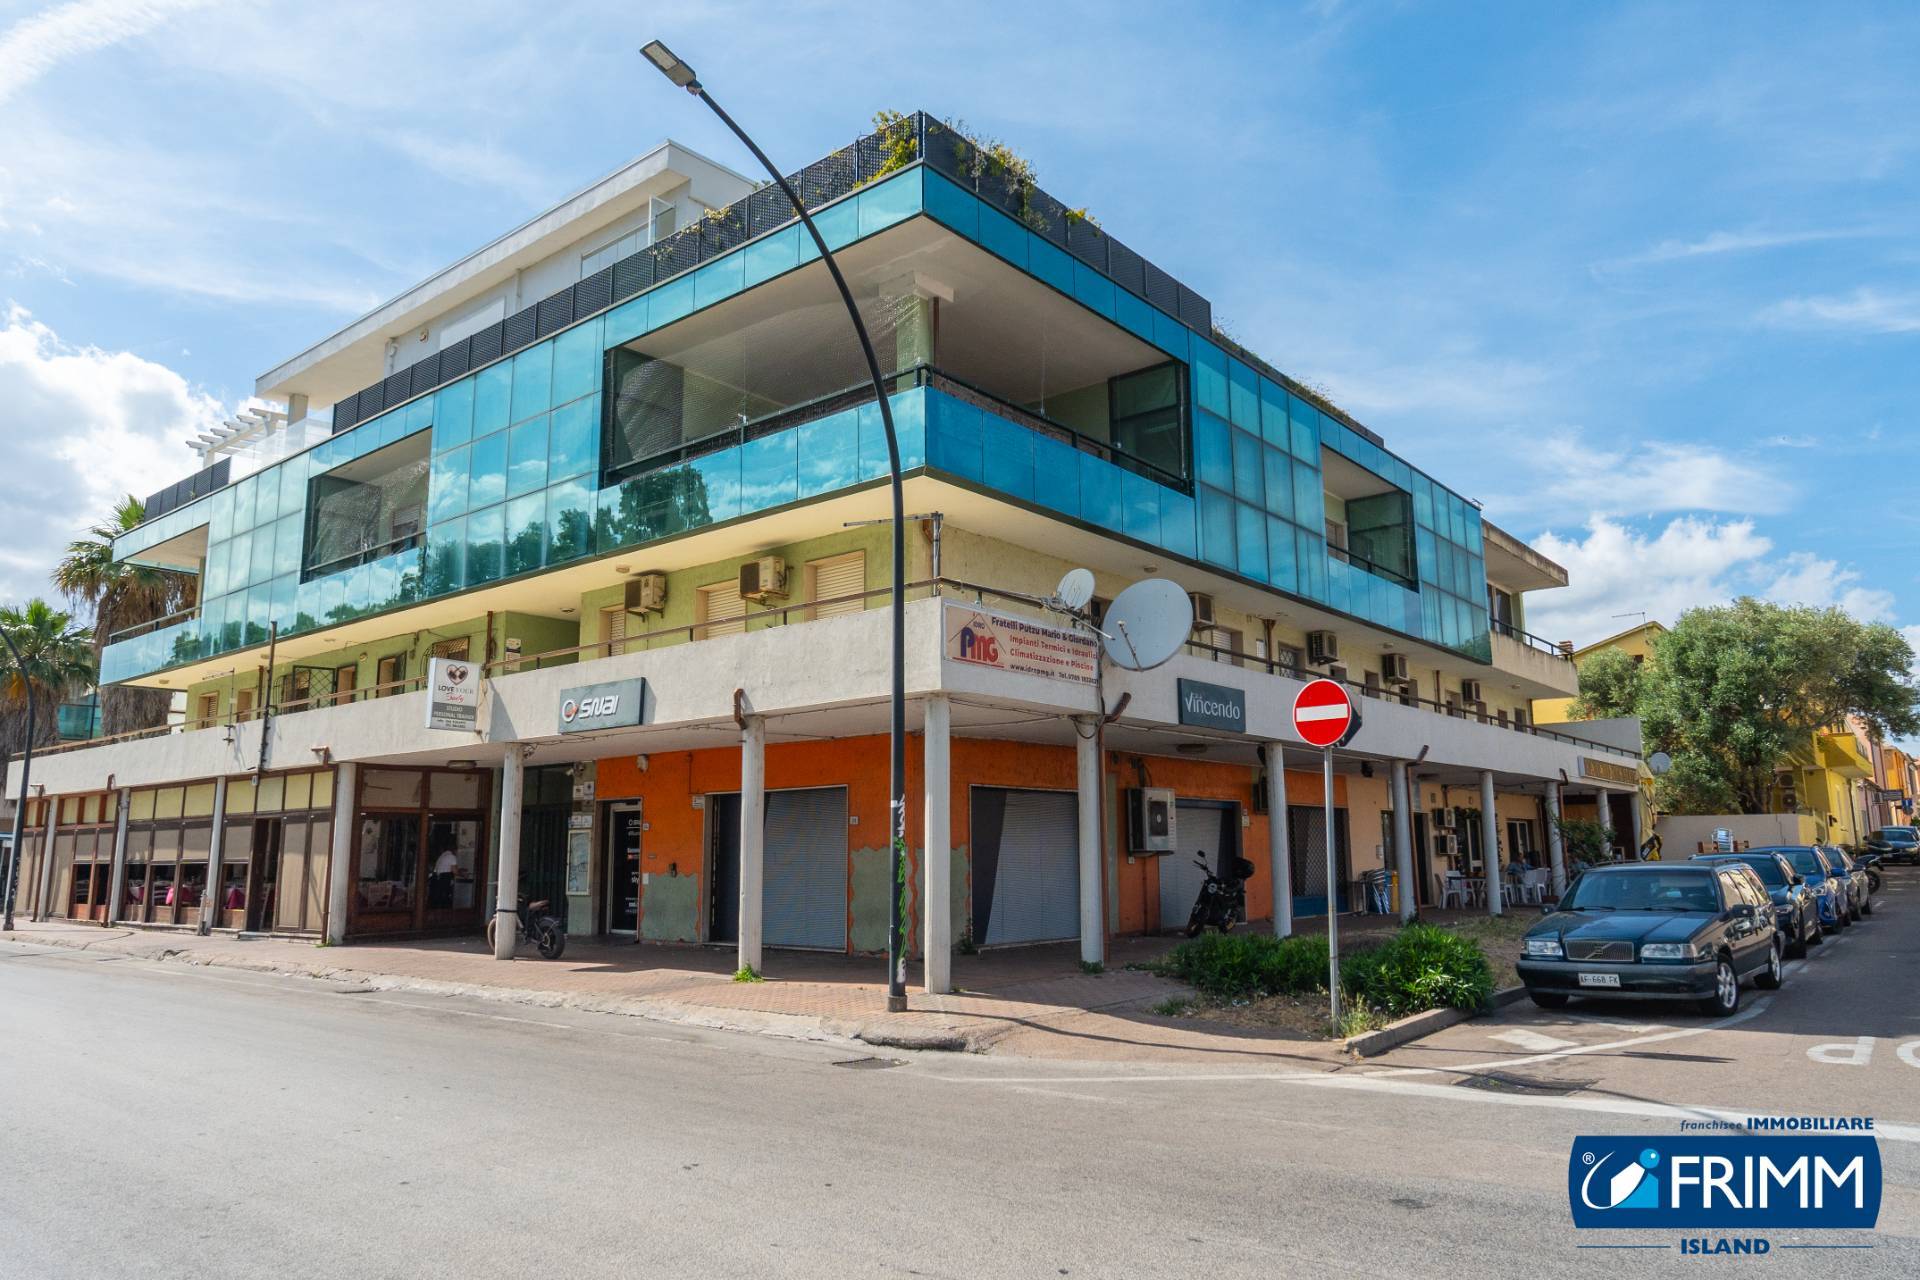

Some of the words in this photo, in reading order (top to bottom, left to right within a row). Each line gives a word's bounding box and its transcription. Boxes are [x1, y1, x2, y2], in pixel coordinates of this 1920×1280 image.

[992, 616, 1018, 630] Fratelli
[1019, 622, 1040, 635] Putzu
[1041, 628, 1061, 640] Mario
[1009, 634, 1039, 649] Impianti
[1041, 641, 1066, 653] Termici
[1010, 648, 1064, 666] Climatizzazione
[437, 684, 454, 692] LOVE
[1185, 691, 1241, 720] Vincendo
